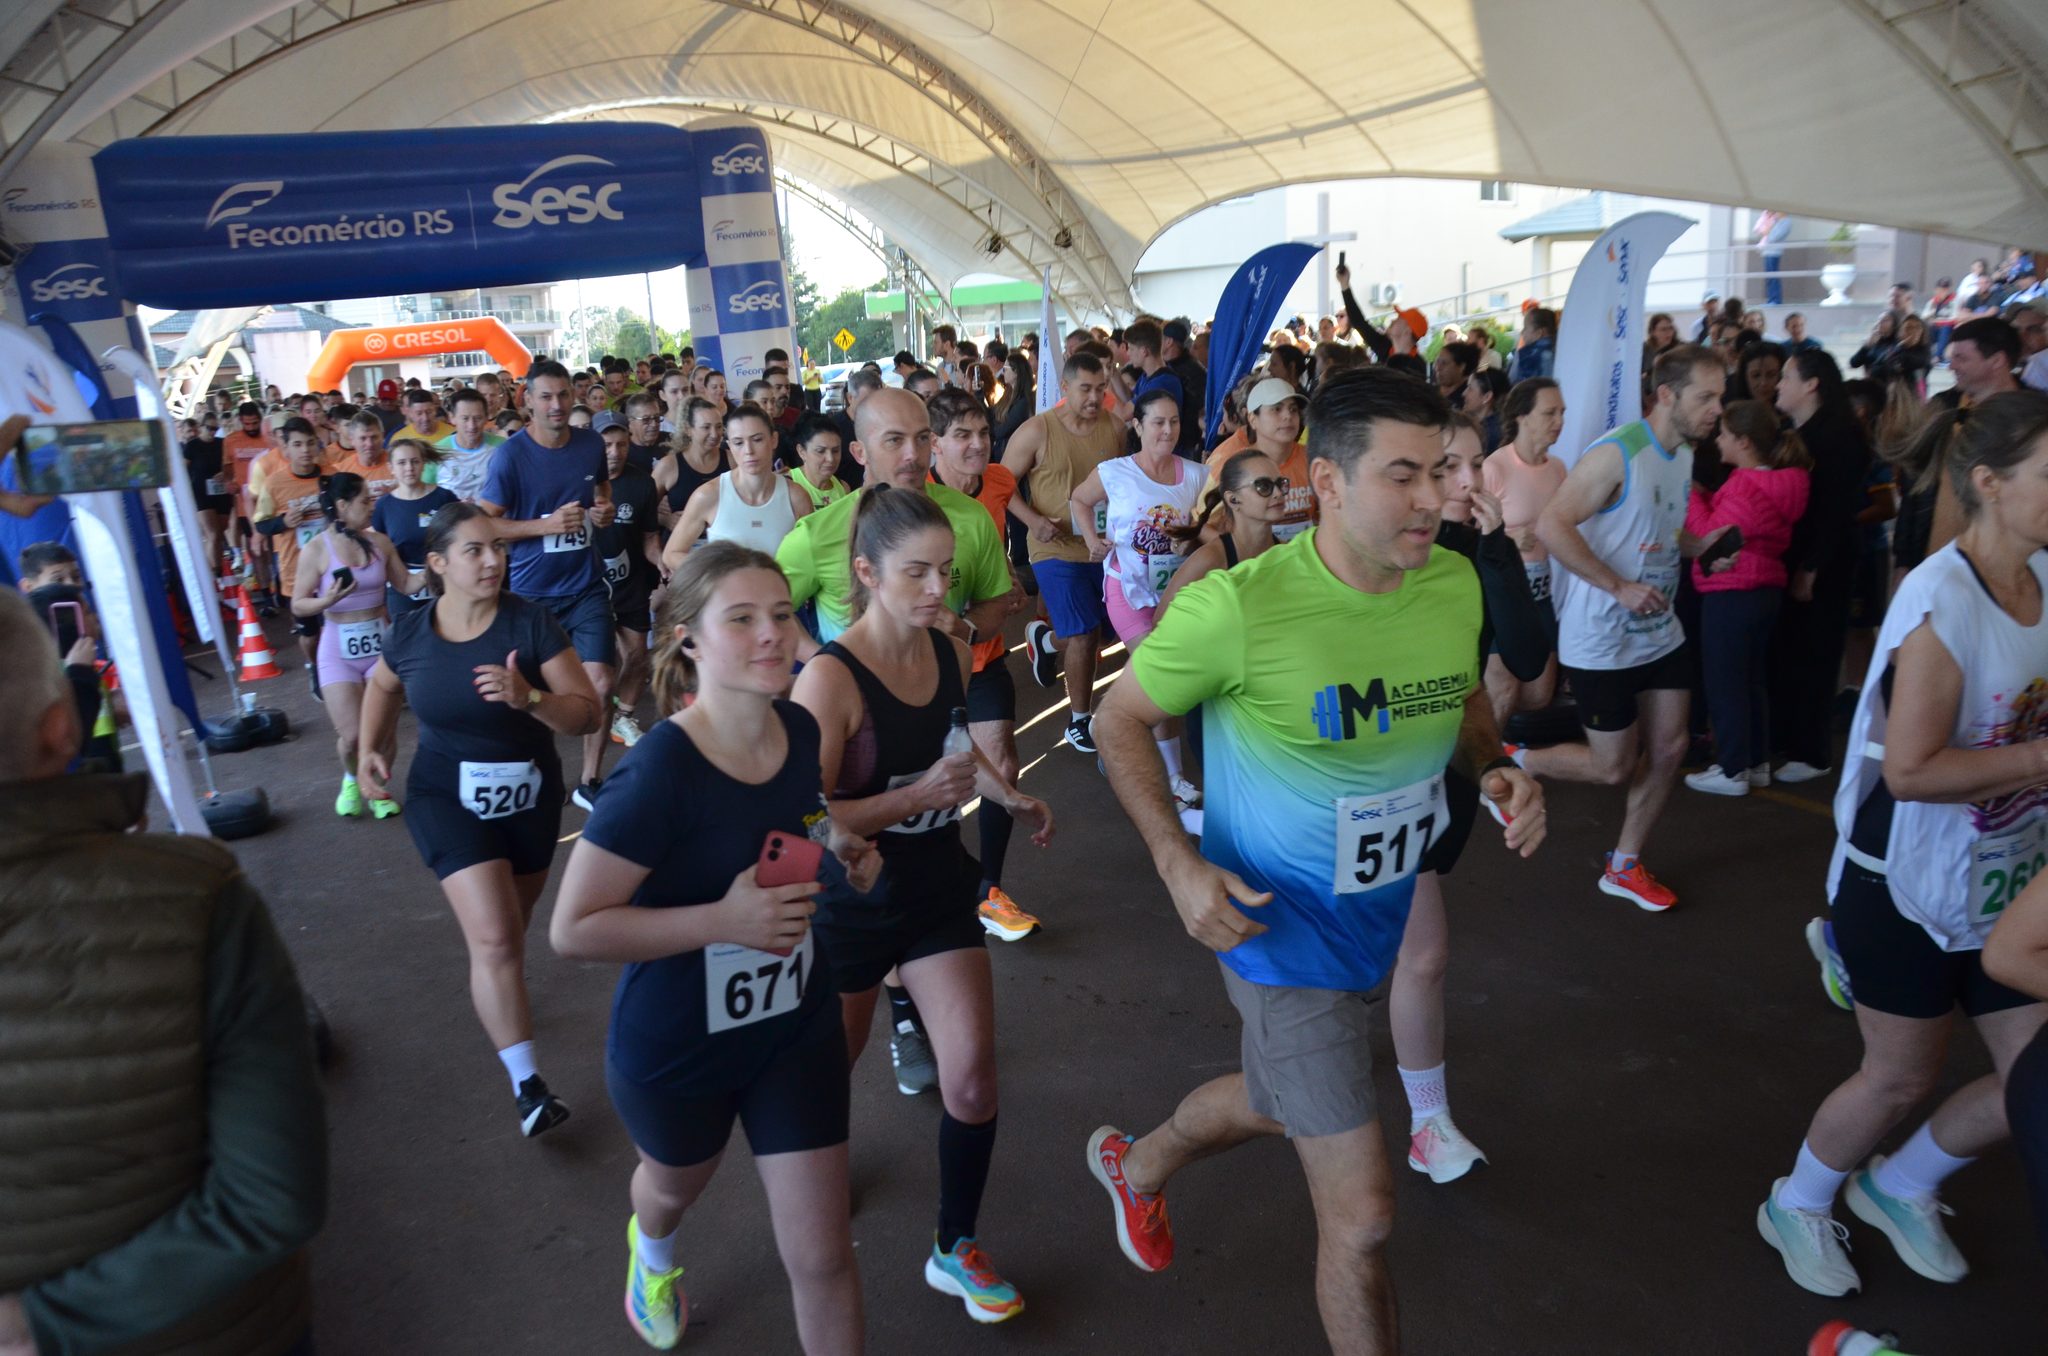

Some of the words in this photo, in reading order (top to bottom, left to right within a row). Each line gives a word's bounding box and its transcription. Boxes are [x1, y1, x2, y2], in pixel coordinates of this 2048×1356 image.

[711, 143, 765, 176] Sesc
[492, 154, 625, 229] Sesc
[228, 214, 406, 249] Fecomércio
[413, 209, 455, 237] RS
[716, 229, 768, 241] Fecomércio
[31, 263, 108, 301] Sesc
[728, 280, 783, 314] Sesc
[392, 327, 472, 350] CRESOL
[347, 632, 382, 656] 663
[473, 782, 531, 816] 520
[1351, 808, 1383, 821] Sesc
[1354, 812, 1436, 885] 517
[724, 950, 804, 1021] 671
